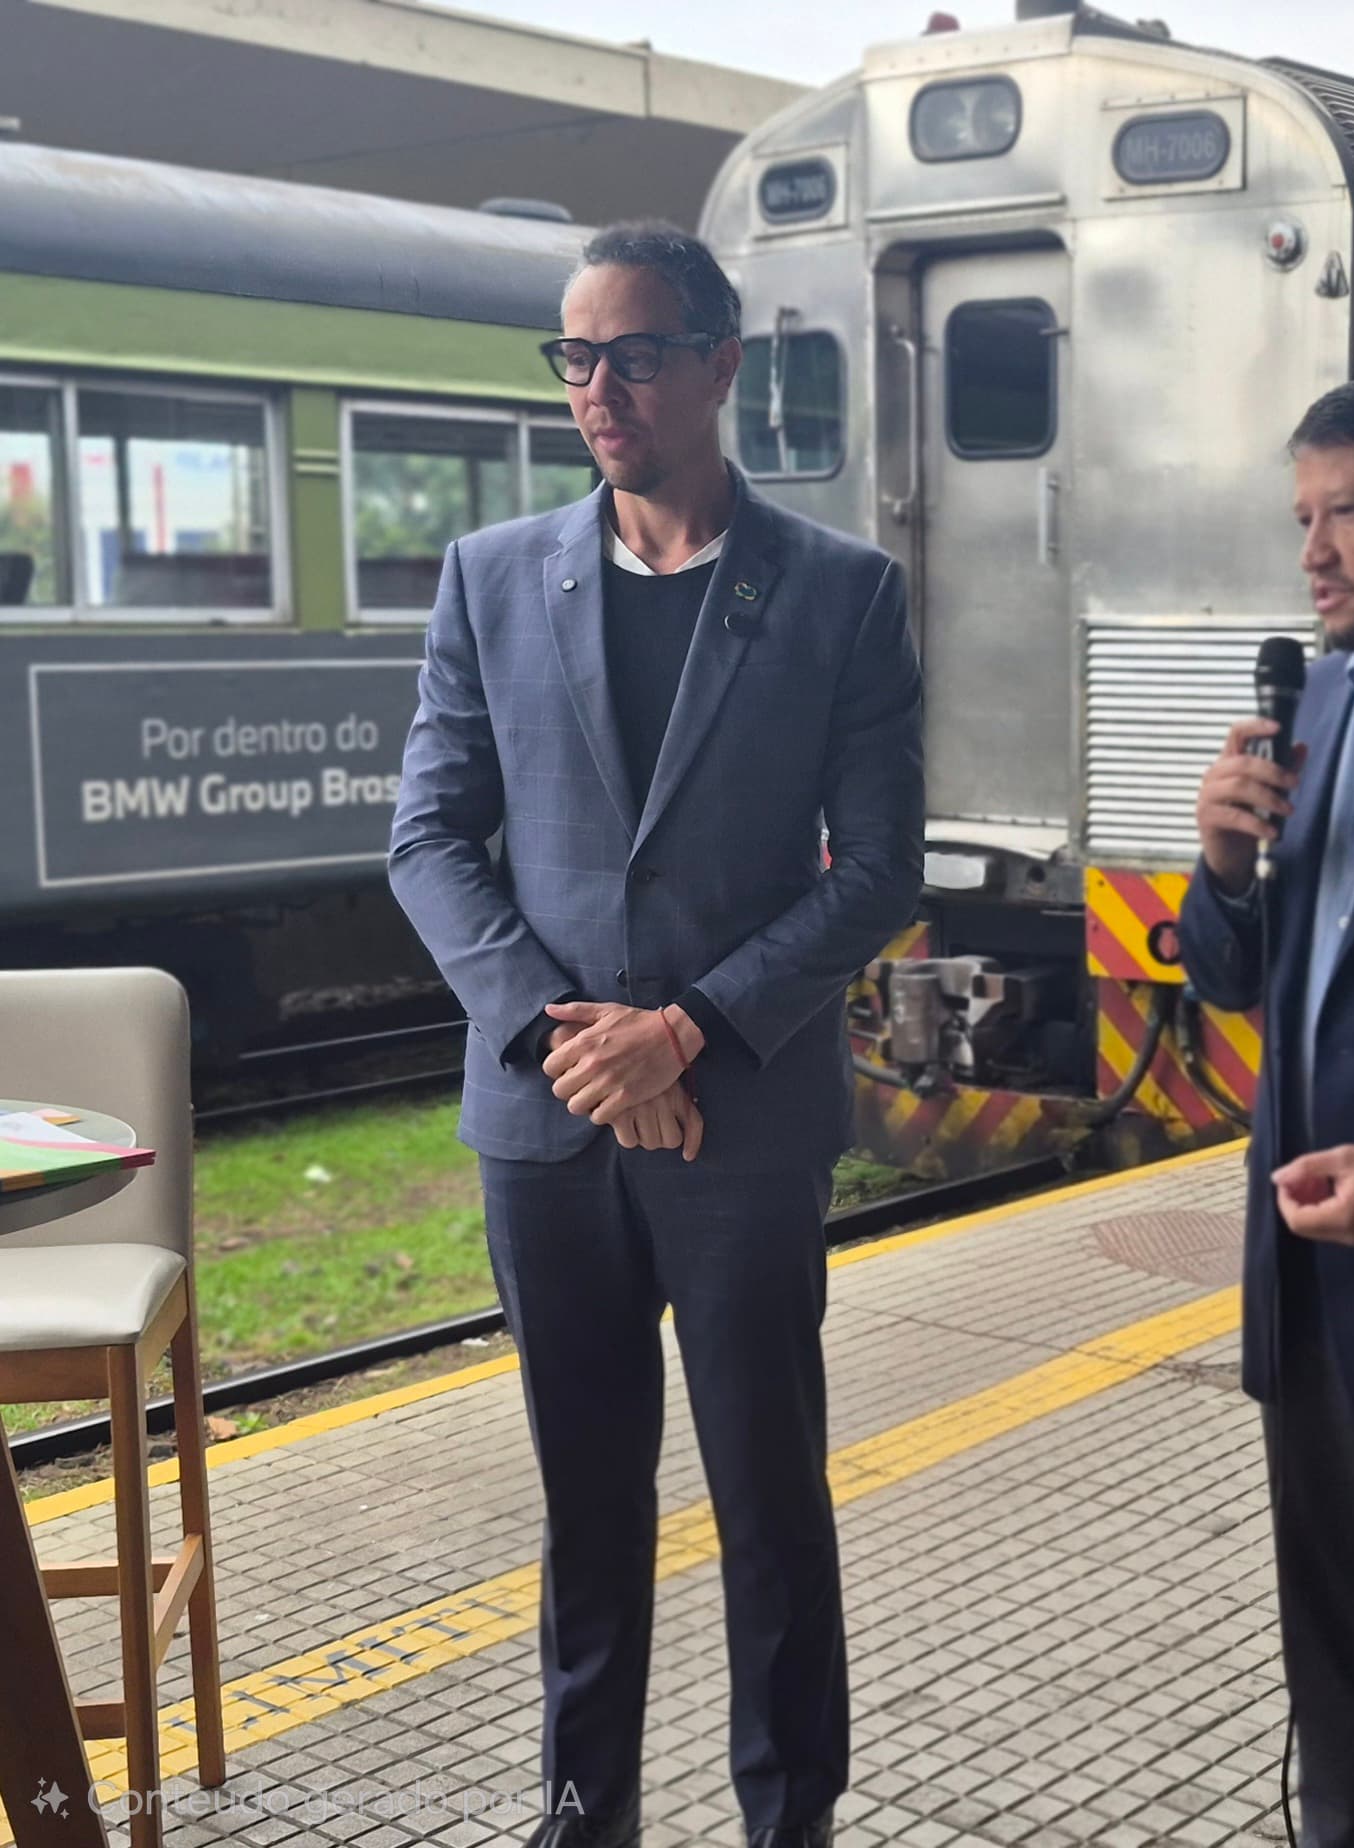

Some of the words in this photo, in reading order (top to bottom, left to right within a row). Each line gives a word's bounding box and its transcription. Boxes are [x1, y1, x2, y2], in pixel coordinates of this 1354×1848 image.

[141, 717, 204, 758] Por
[213, 715, 326, 756] dentro
[335, 713, 379, 752] do
[81, 776, 189, 822] BMW
[200, 774, 313, 818] Group
[321, 767, 402, 805] Bras
